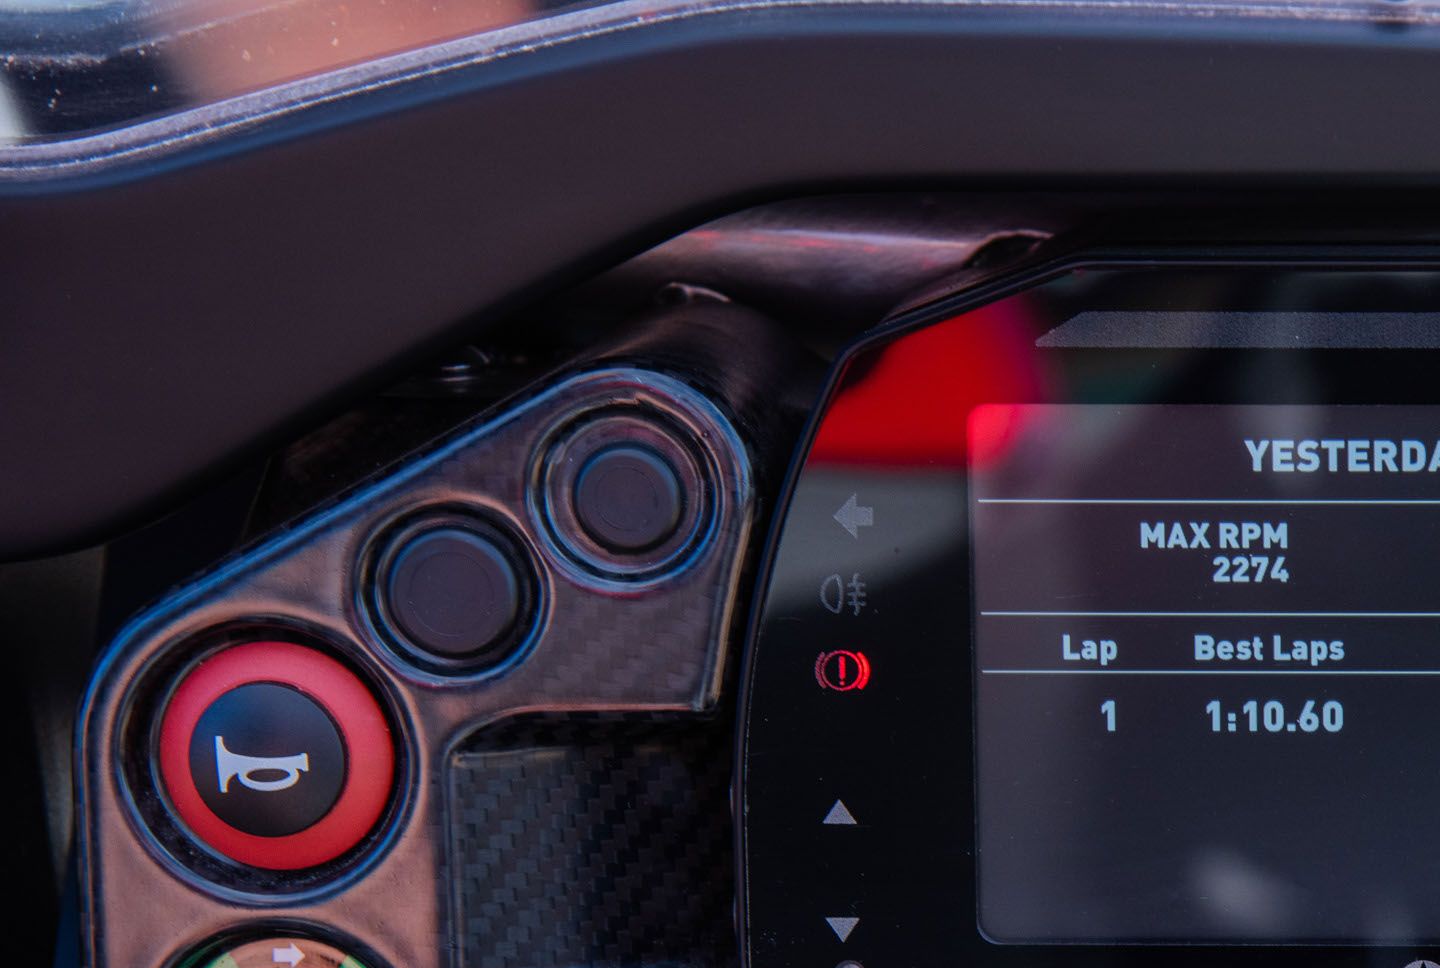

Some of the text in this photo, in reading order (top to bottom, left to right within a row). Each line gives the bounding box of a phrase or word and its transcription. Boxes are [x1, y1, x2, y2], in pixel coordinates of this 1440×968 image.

[1140, 522, 1288, 549] MAX RPM
[1212, 556, 1290, 583] 2274
[1062, 633, 1118, 666] Lap
[1194, 634, 1345, 667] Best Laps
[1101, 700, 1117, 732] 1
[1206, 700, 1344, 733] 1:10.60
